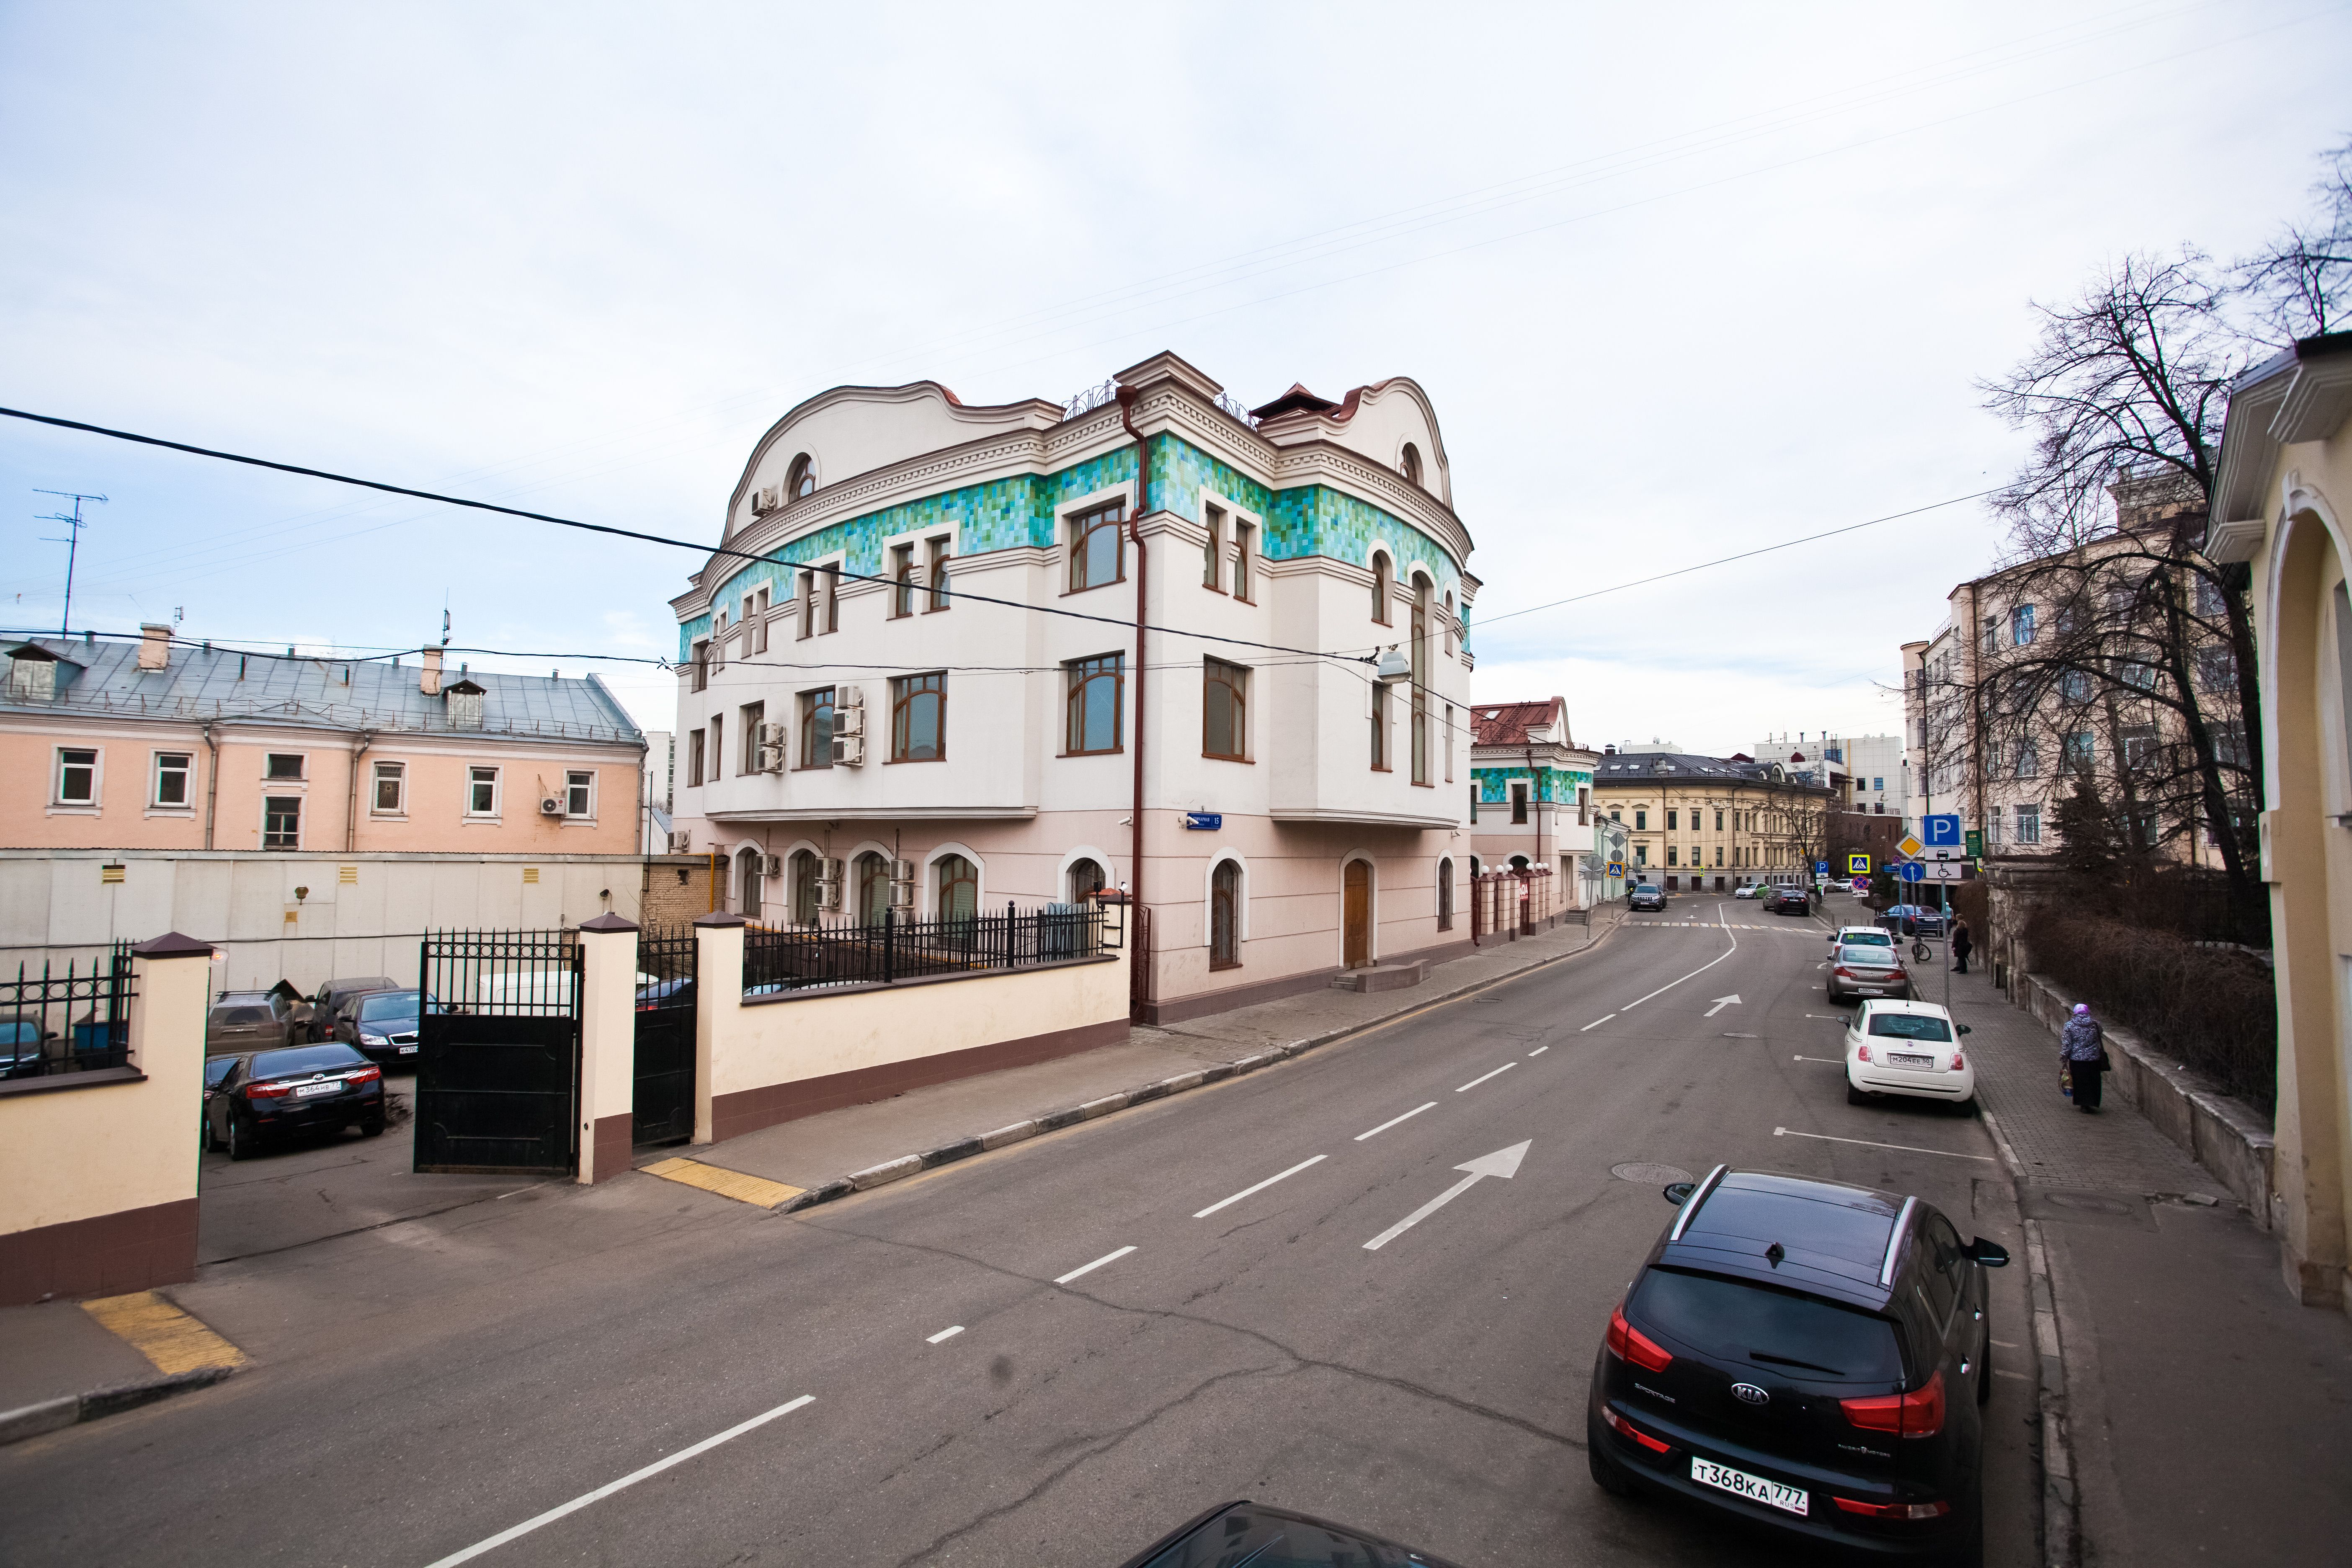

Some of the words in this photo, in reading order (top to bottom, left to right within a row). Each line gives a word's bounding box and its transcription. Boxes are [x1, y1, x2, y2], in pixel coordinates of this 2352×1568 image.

[1933, 820, 1951, 841] P
[299, 1085, 329, 1093] М364НВ
[1635, 1383, 1675, 1403] SPORTAGE
[1738, 1386, 1762, 1402] KIA
[1698, 1465, 1768, 1501] Т368КА
[1773, 1479, 1802, 1505] 777
[1780, 1500, 1794, 1509] RUS
